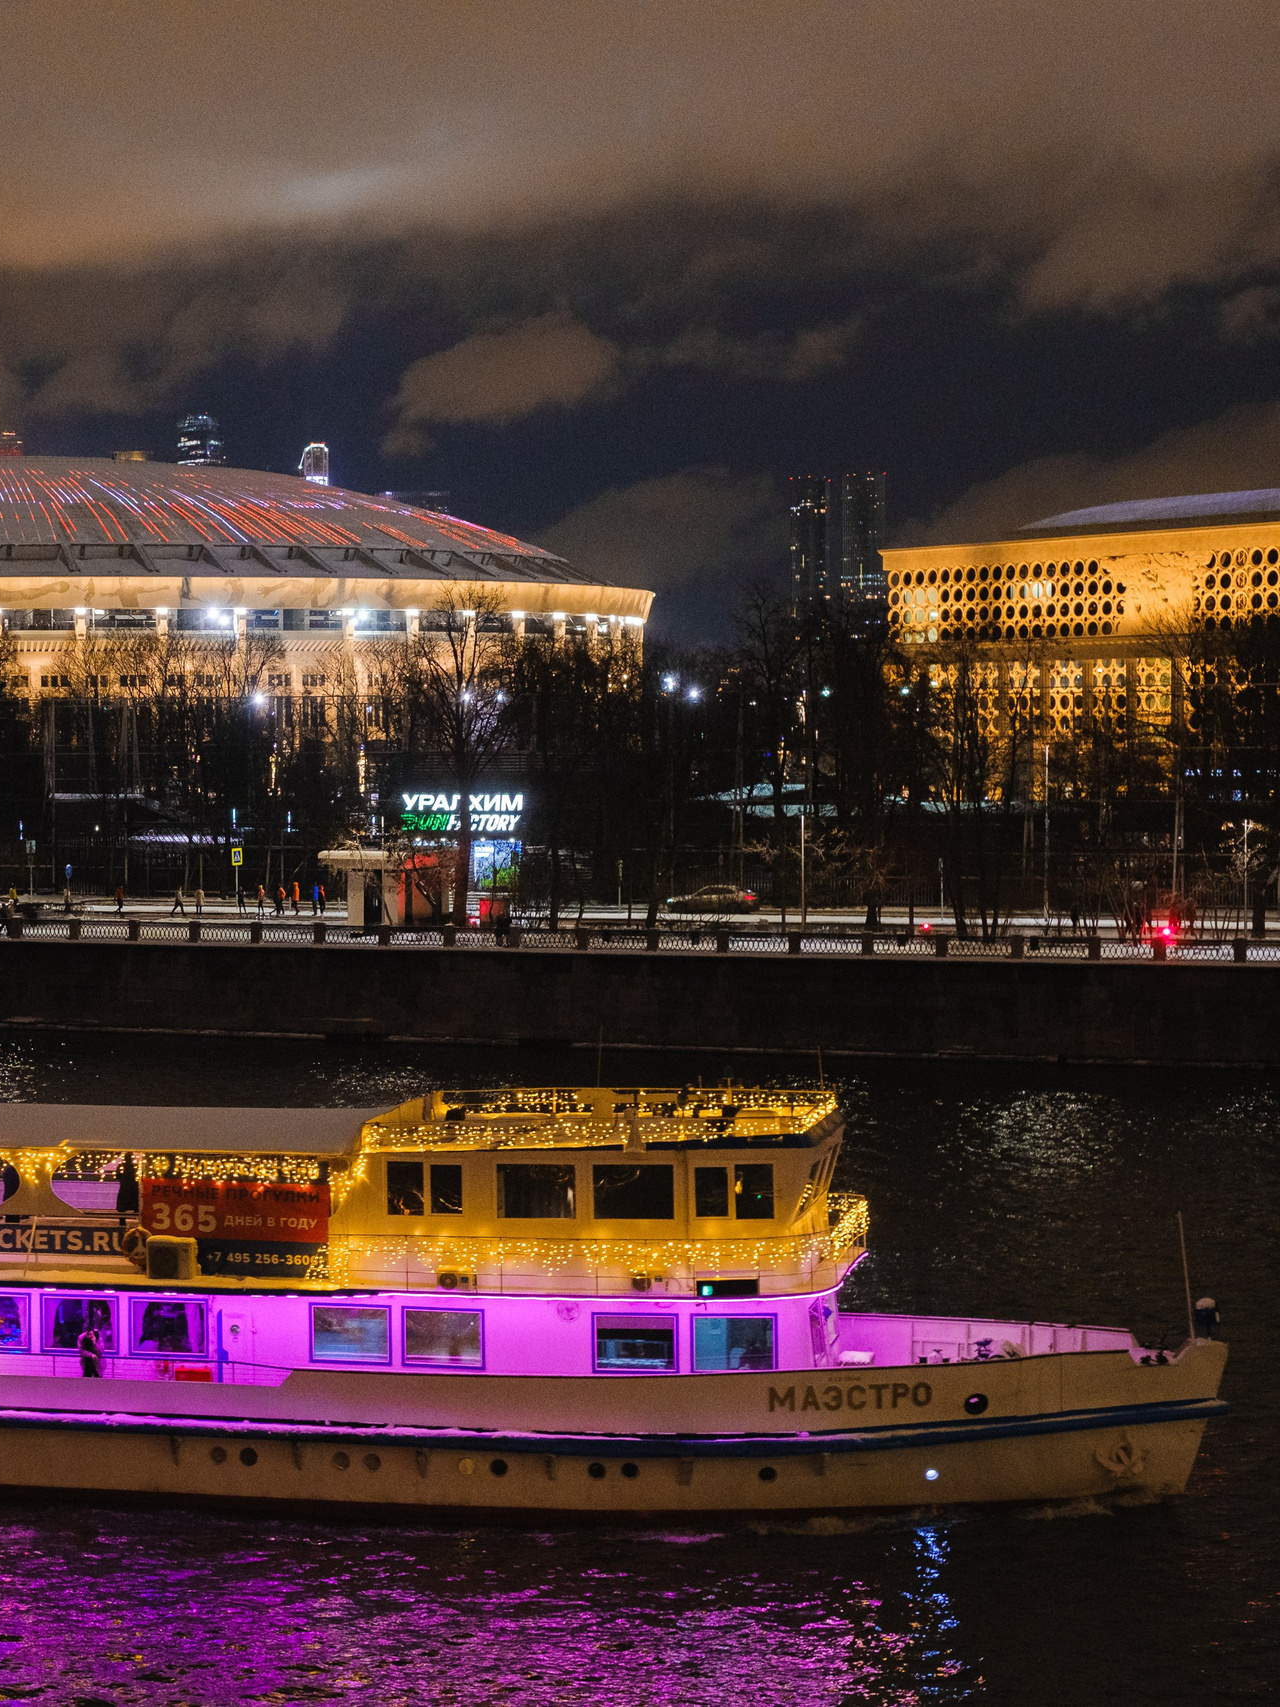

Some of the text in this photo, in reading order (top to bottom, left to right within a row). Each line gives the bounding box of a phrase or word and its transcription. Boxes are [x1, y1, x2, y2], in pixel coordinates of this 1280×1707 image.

[151, 1185, 320, 1203] РЕЧНЫЕ ПРОГУЛКИ
[151, 1202, 318, 1233] 365 ДНЕЙ В ГОДУ
[206, 1251, 222, 1262] +7
[226, 1252, 251, 1263] 495
[768, 1382, 933, 1412] МАЭСТРО
